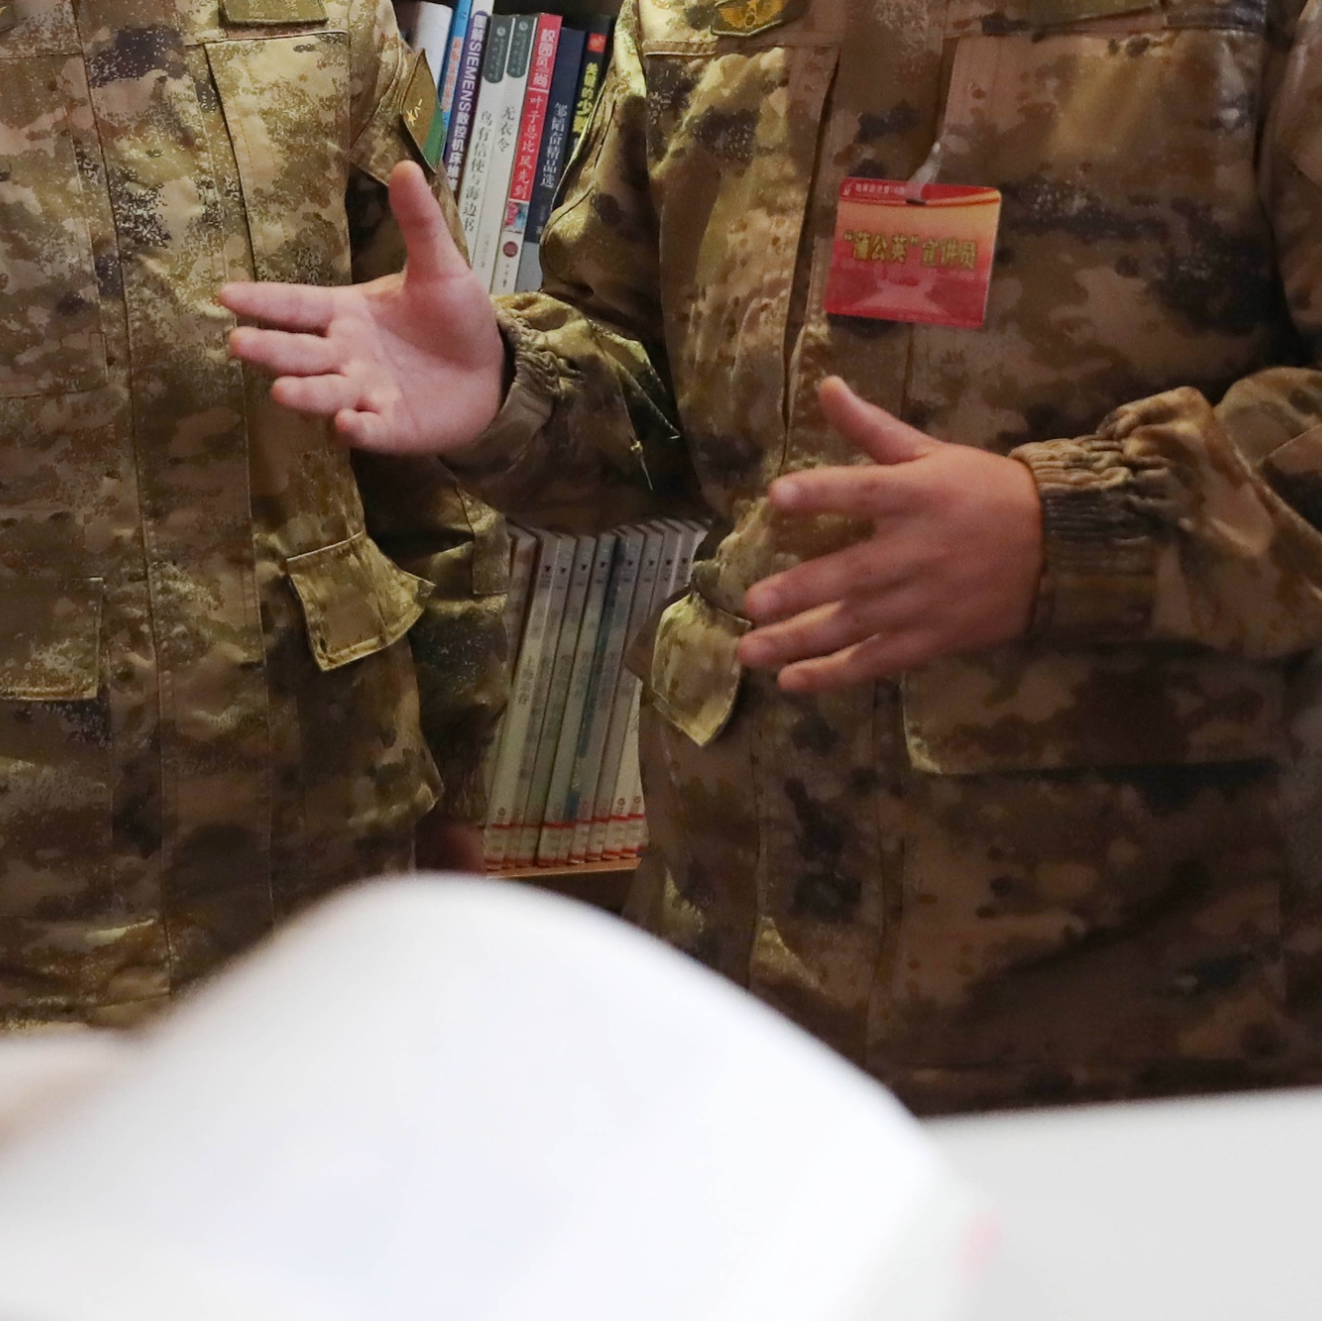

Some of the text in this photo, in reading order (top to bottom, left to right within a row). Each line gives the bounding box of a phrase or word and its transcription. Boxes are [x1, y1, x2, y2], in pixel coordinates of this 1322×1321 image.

[497, 105, 515, 153] 无衣令
[514, 94, 544, 199] 叶子总比风先到
